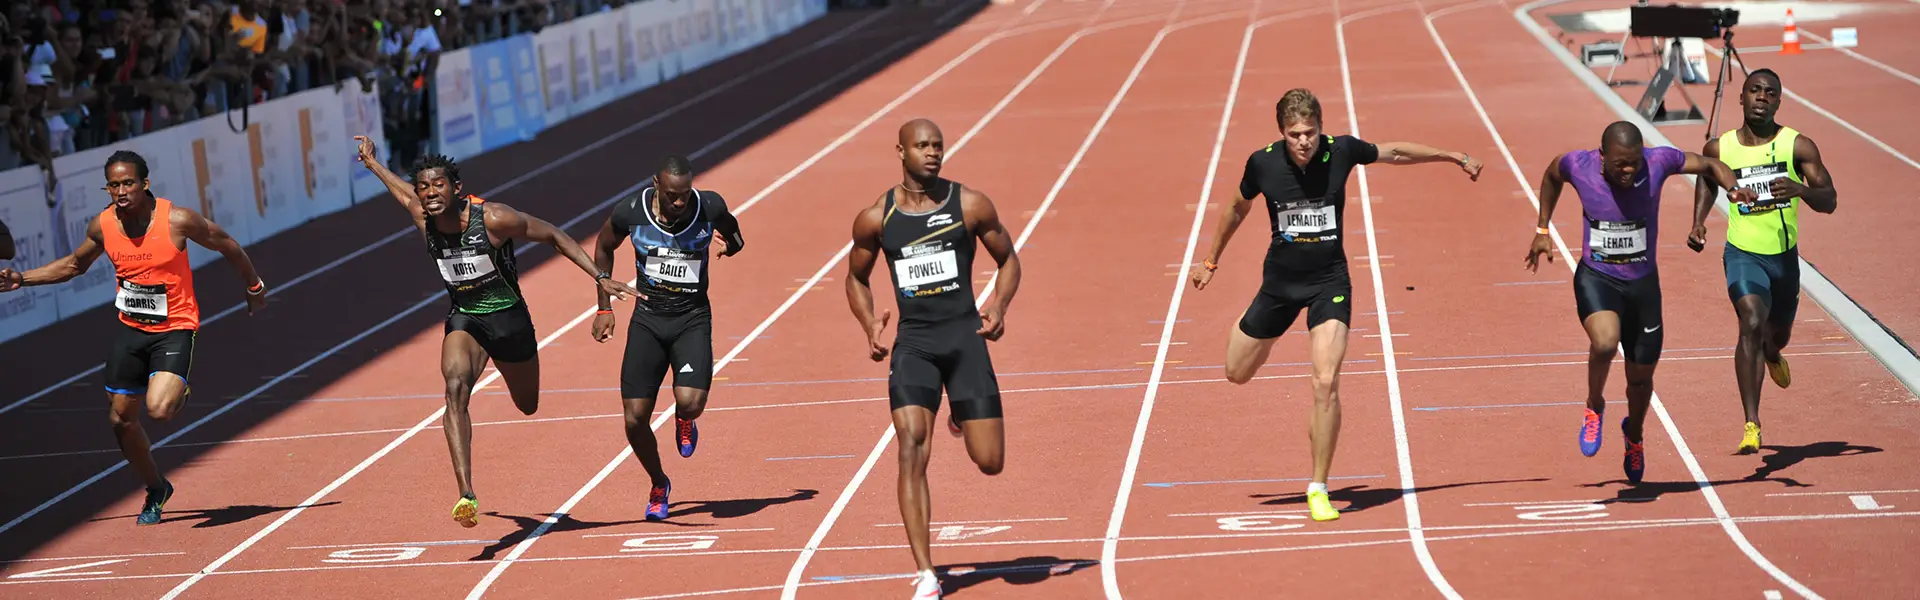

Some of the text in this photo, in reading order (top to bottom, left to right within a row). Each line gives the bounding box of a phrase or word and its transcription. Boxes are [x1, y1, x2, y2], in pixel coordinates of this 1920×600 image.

[1745, 181, 1769, 194] ARN
[1287, 213, 1328, 227] LEMAITRE
[1603, 237, 1634, 249] LEHATA
[112, 251, 153, 262] Ultimate
[452, 262, 477, 276] KOFFI
[659, 262, 688, 278] BAILEY
[908, 260, 945, 280] POWELL
[1514, 504, 1610, 520] 2
[1216, 515, 1308, 530] 3
[619, 535, 719, 552] 5
[321, 547, 426, 563] 6
